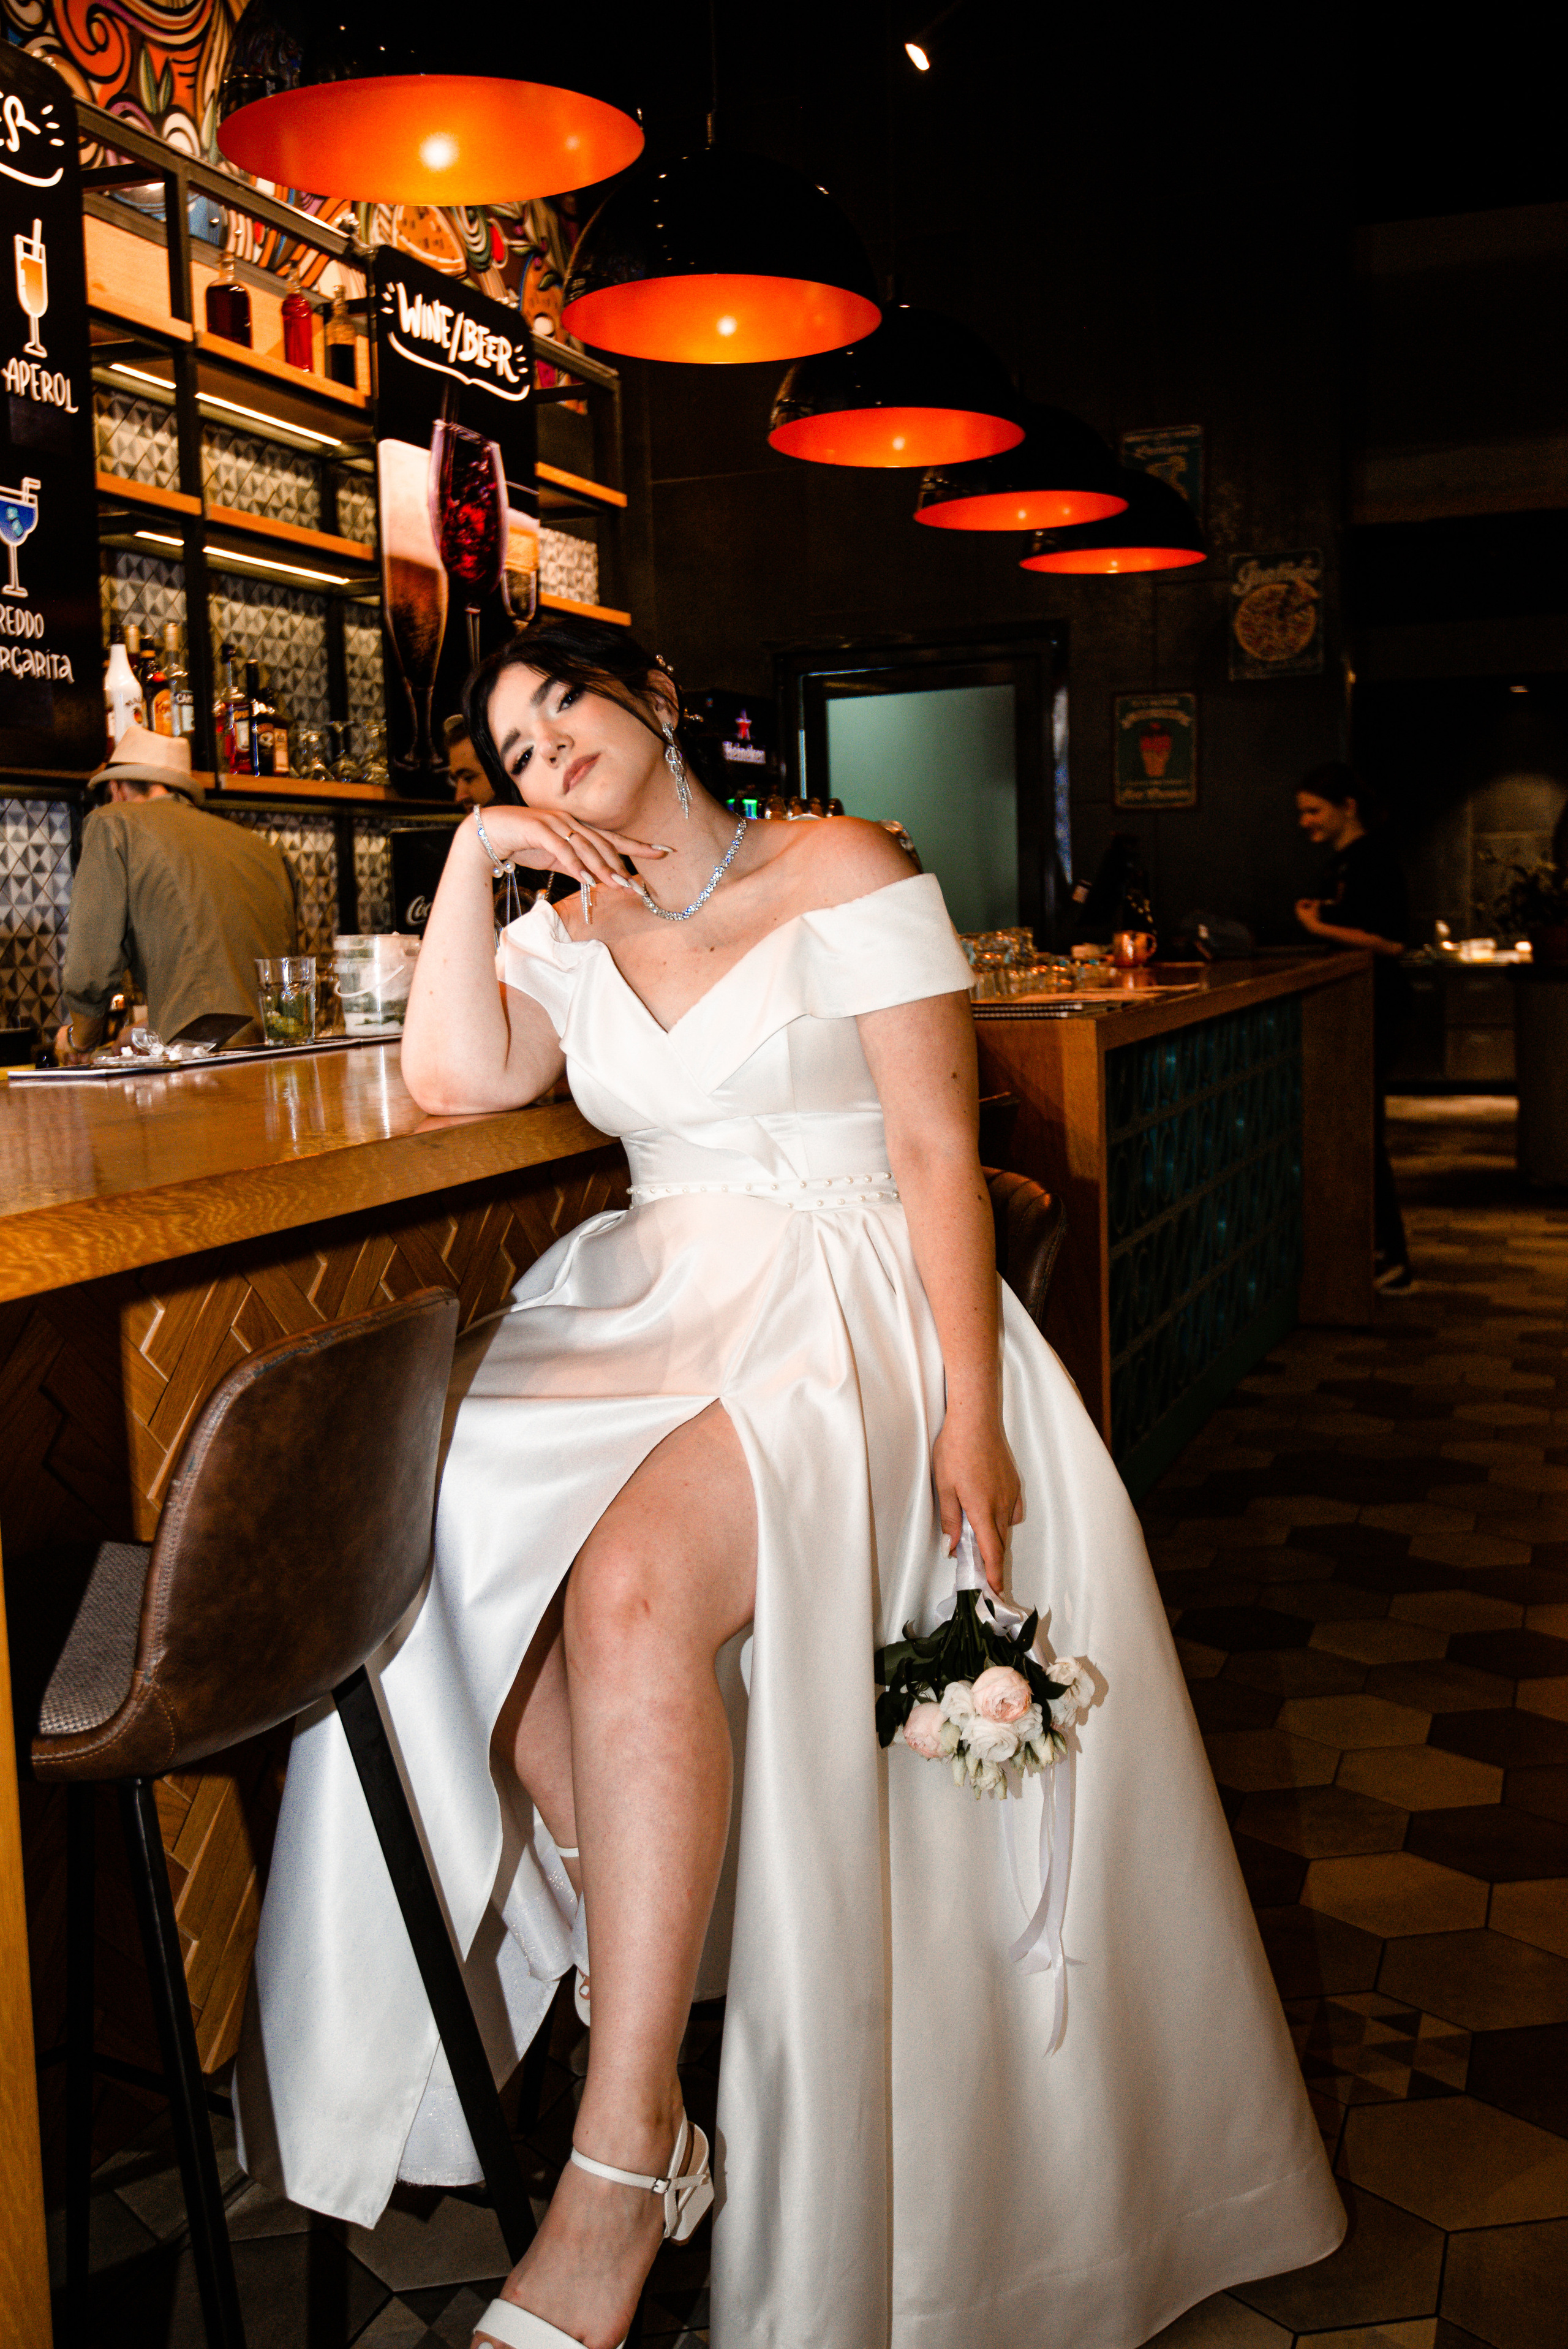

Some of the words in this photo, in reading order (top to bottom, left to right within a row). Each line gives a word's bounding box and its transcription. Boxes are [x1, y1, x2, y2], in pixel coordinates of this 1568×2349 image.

[0, 91, 41, 153] R
[396, 282, 519, 383] WINE/BEER
[1, 357, 79, 414] APEROL
